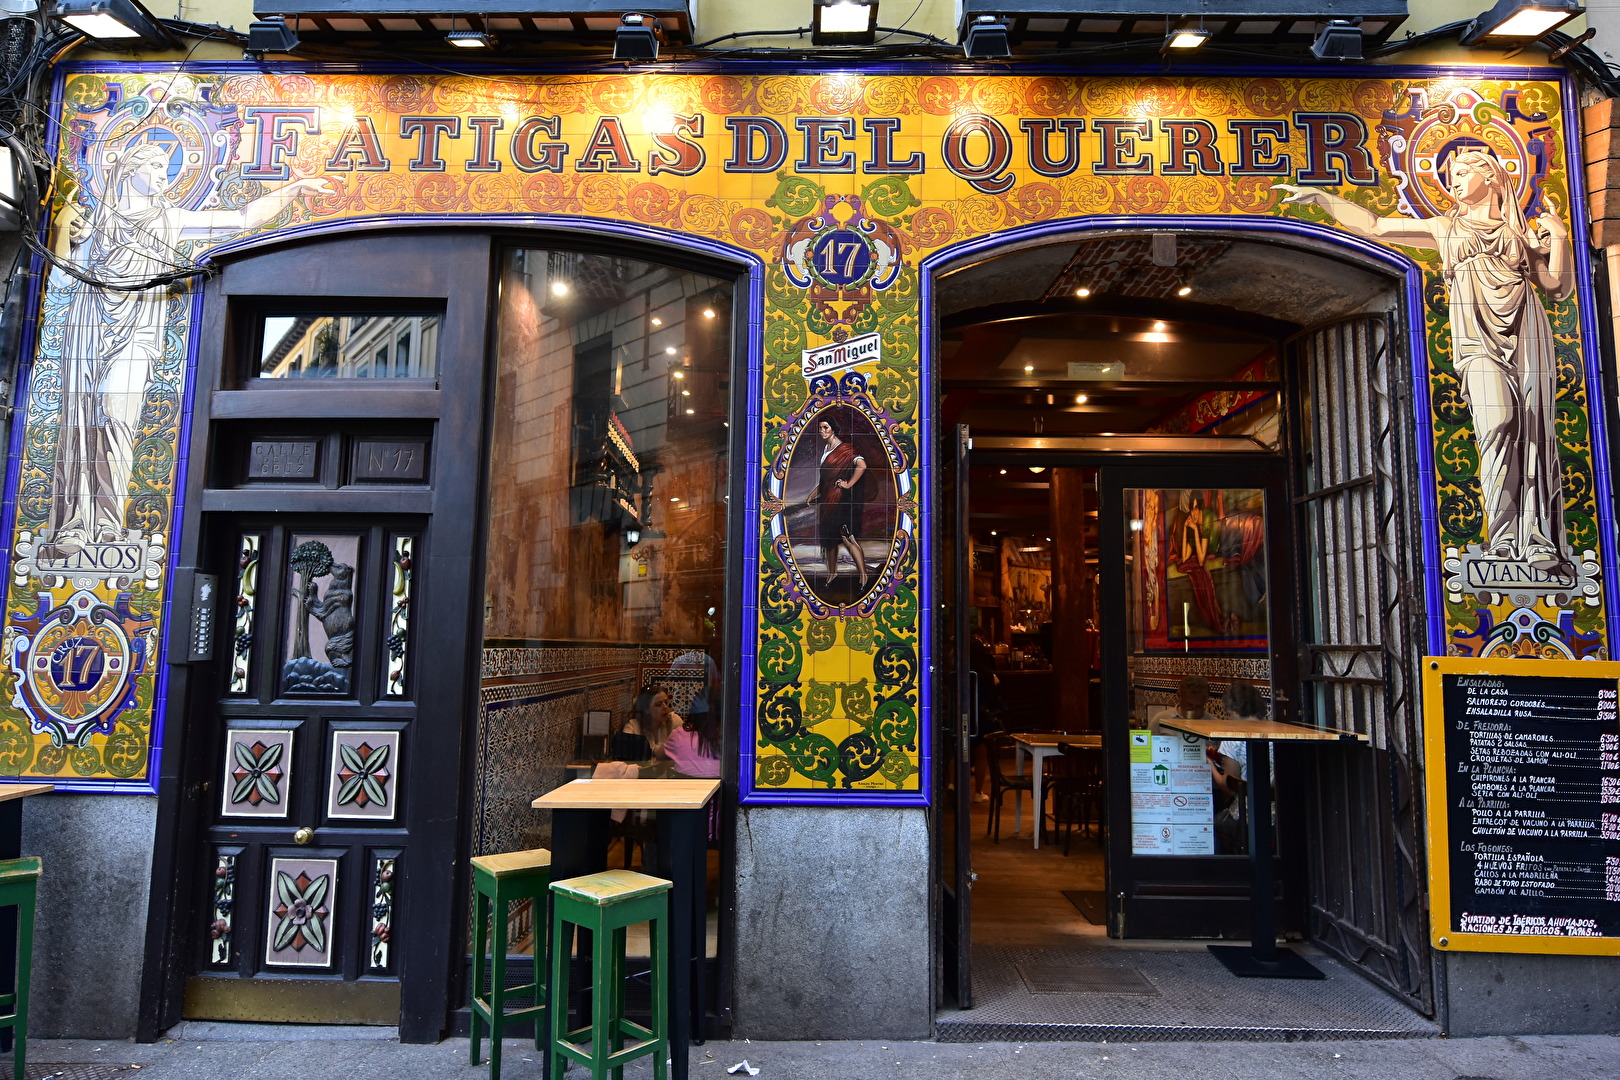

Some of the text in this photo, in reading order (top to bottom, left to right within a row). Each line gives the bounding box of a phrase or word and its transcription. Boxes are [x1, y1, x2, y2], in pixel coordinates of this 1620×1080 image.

[240, 105, 1379, 193] FATIGAS DEL QUERER
[820, 238, 862, 278] 17
[255, 444, 312, 456] CALLE
[392, 449, 416, 473] 17
[260, 463, 305, 475] CRUZ
[51, 637, 83, 664] CRUZ
[57, 645, 101, 688] 17
[1457, 677, 1505, 688] ENSALADAS:
[1491, 688, 1509, 696] CASA
[1466, 697, 1507, 707] SALMOREJO
[1510, 700, 1546, 708] CORDOBÉS
[1466, 707, 1512, 717] ENSALADILLA
[1514, 710, 1532, 718] RUSA
[1456, 720, 1512, 731] DE FREIDORA:
[1469, 731, 1502, 740] TORTILLAS
[1504, 732, 1512, 740] DE
[1514, 733, 1554, 742] CAMARONES
[1469, 738, 1496, 747] PATATAS
[1504, 740, 1527, 748] SALSAS
[1470, 746, 1491, 755] SETAS
[1492, 748, 1533, 757] REBOZADAS
[1536, 750, 1550, 758] CON
[1470, 754, 1513, 763] CROQUETAS
[1514, 756, 1524, 764] DE
[1457, 762, 1517, 775] EN LA PLANCHA:
[1470, 774, 1510, 783] CHIPIRONES
[1512, 775, 1517, 783] A
[1519, 776, 1527, 784] LA
[1529, 775, 1556, 784] PLANCHA
[1471, 782, 1508, 791] GAMBONES
[1510, 784, 1515, 792] A
[1529, 784, 1556, 793] PLANCHA
[1471, 790, 1494, 798] SEPIA
[1458, 796, 1510, 809] A LA PARRILLA:
[1472, 808, 1493, 817] POLLO
[1503, 810, 1512, 818] LA
[1514, 810, 1546, 818] PARRILLA
[1510, 819, 1519, 827] DE
[1522, 819, 1548, 828] VACUNO
[1557, 820, 1566, 828] LA
[1567, 820, 1596, 829] PARRILLA
[1472, 826, 1506, 836] CHULETÓN
[1507, 828, 1516, 836] DE
[1518, 828, 1543, 837] VACUNO
[1544, 829, 1549, 837] A
[1550, 829, 1559, 837] LA
[1560, 830, 1588, 838] PARRILLA
[1460, 841, 1513, 853] LOS FOGONES:
[1473, 852, 1505, 861] TORTILLA
[1507, 852, 1544, 862] ESPAÑOLA
[1476, 861, 1483, 870] 4
[1484, 861, 1513, 870] HUEVOS
[1516, 862, 1543, 872] FRITOS
[1473, 869, 1499, 879] CALLOS
[1501, 871, 1507, 879] A
[1508, 871, 1517, 879] LA
[1518, 870, 1559, 880] MADRILEÑA
[1474, 878, 1493, 887] RABO
[1493, 879, 1502, 887] DE
[1502, 880, 1520, 888] TORO
[1520, 881, 1555, 889] ESTOFADO
[1474, 886, 1505, 895] GAMBÓN
[1508, 888, 1518, 896] AL
[1520, 889, 1545, 897] AJILLO
[1460, 912, 1496, 924] SURTIDO
[1498, 916, 1511, 926] DE
[1548, 917, 1598, 929] AHUMADOS,
[1460, 922, 1505, 934] RACIONES
[1505, 925, 1519, 934] DE
